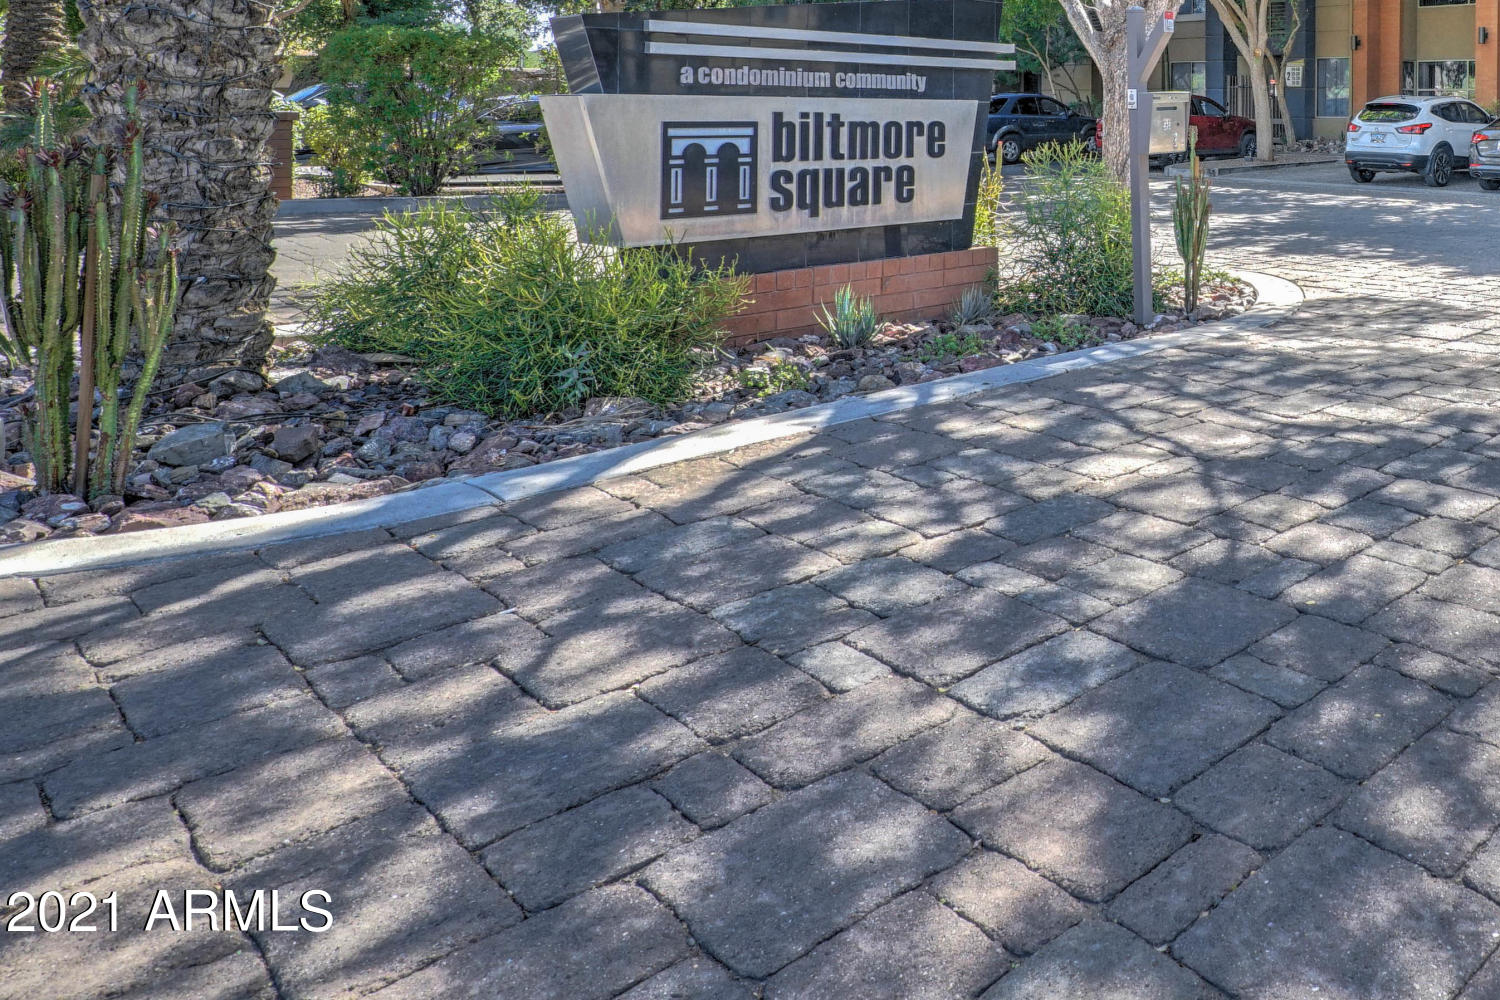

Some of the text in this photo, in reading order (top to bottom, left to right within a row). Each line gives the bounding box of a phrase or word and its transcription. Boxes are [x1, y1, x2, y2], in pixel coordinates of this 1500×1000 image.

[680, 66, 927, 93] a condominium community
[772, 111, 946, 162] biltmore
[769, 164, 915, 218] square
